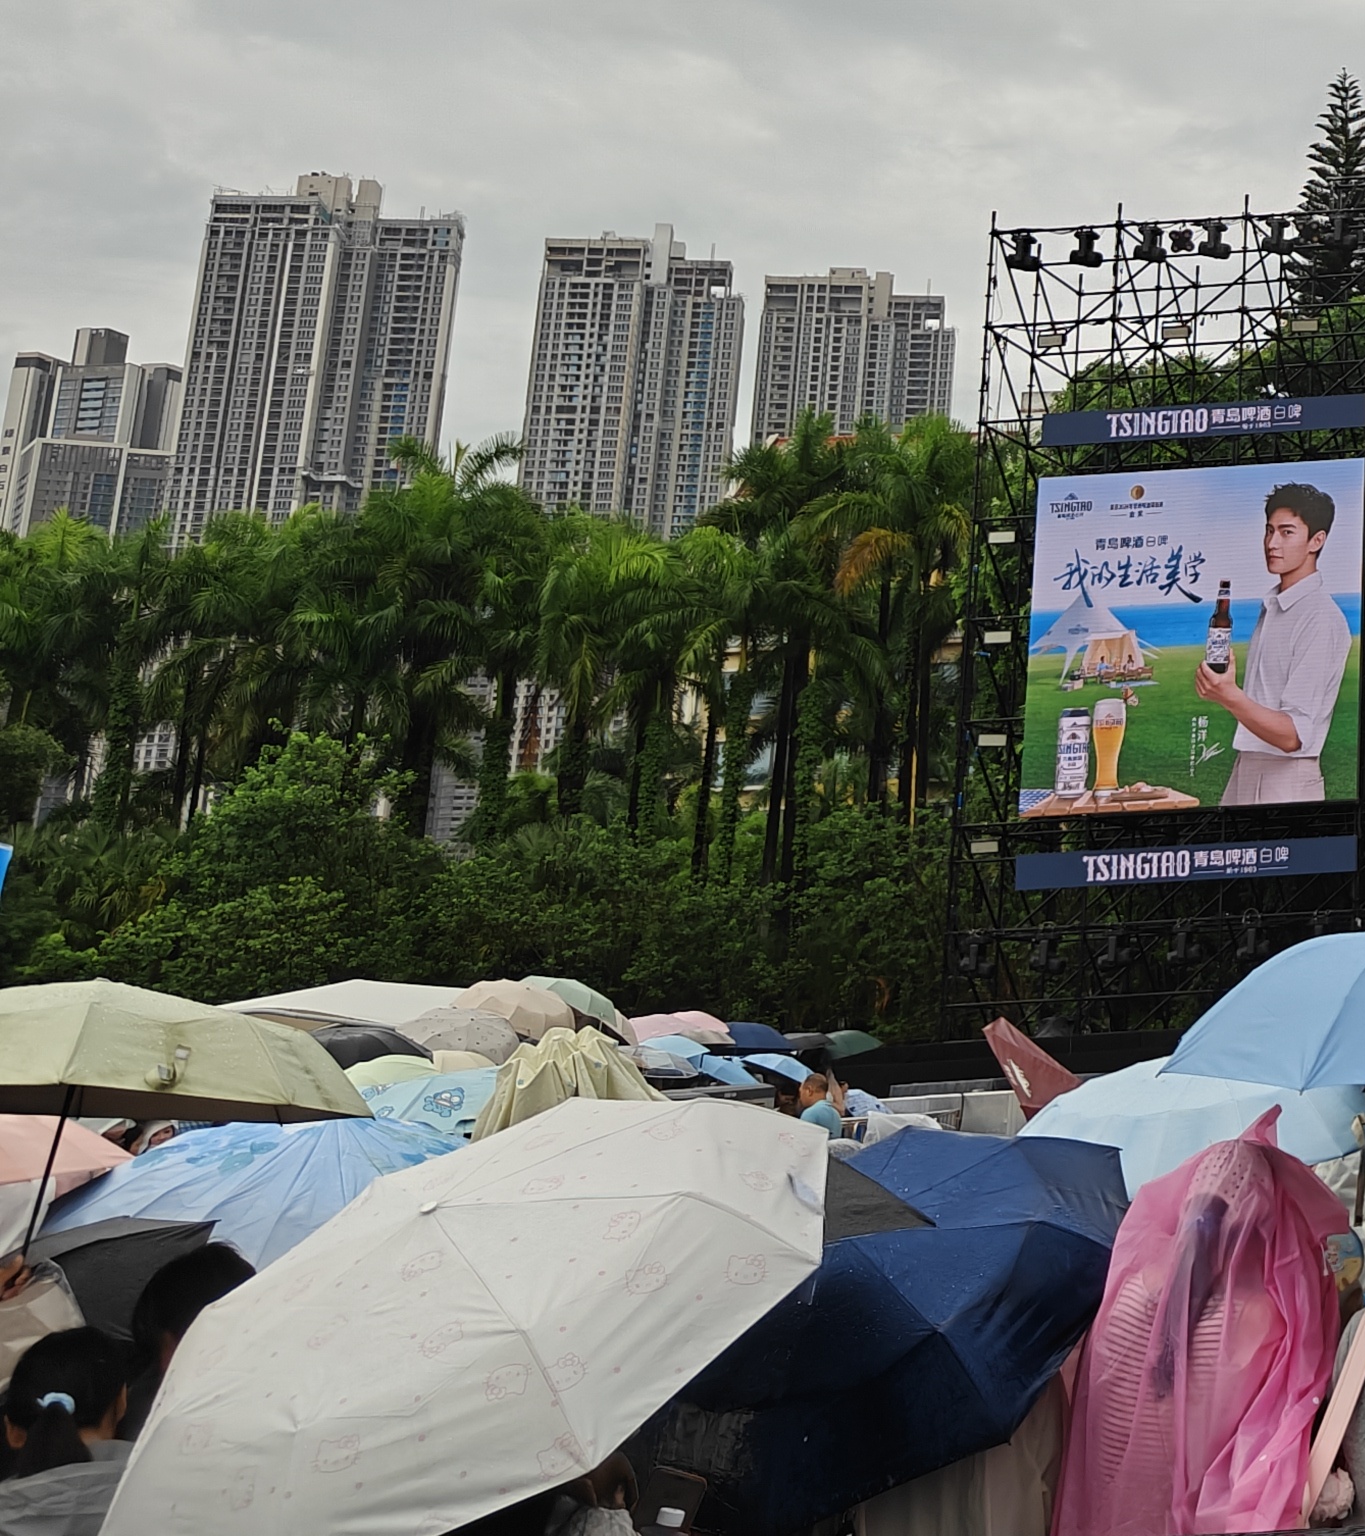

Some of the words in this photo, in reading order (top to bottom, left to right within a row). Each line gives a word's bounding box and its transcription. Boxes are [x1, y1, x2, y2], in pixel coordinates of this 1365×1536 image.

[1106, 408, 1209, 437] TSINGTAO
[1050, 501, 1093, 513] TSINGTAO
[1053, 545, 1206, 608] 我的生活美学
[1082, 850, 1190, 882] TSINGTAO
